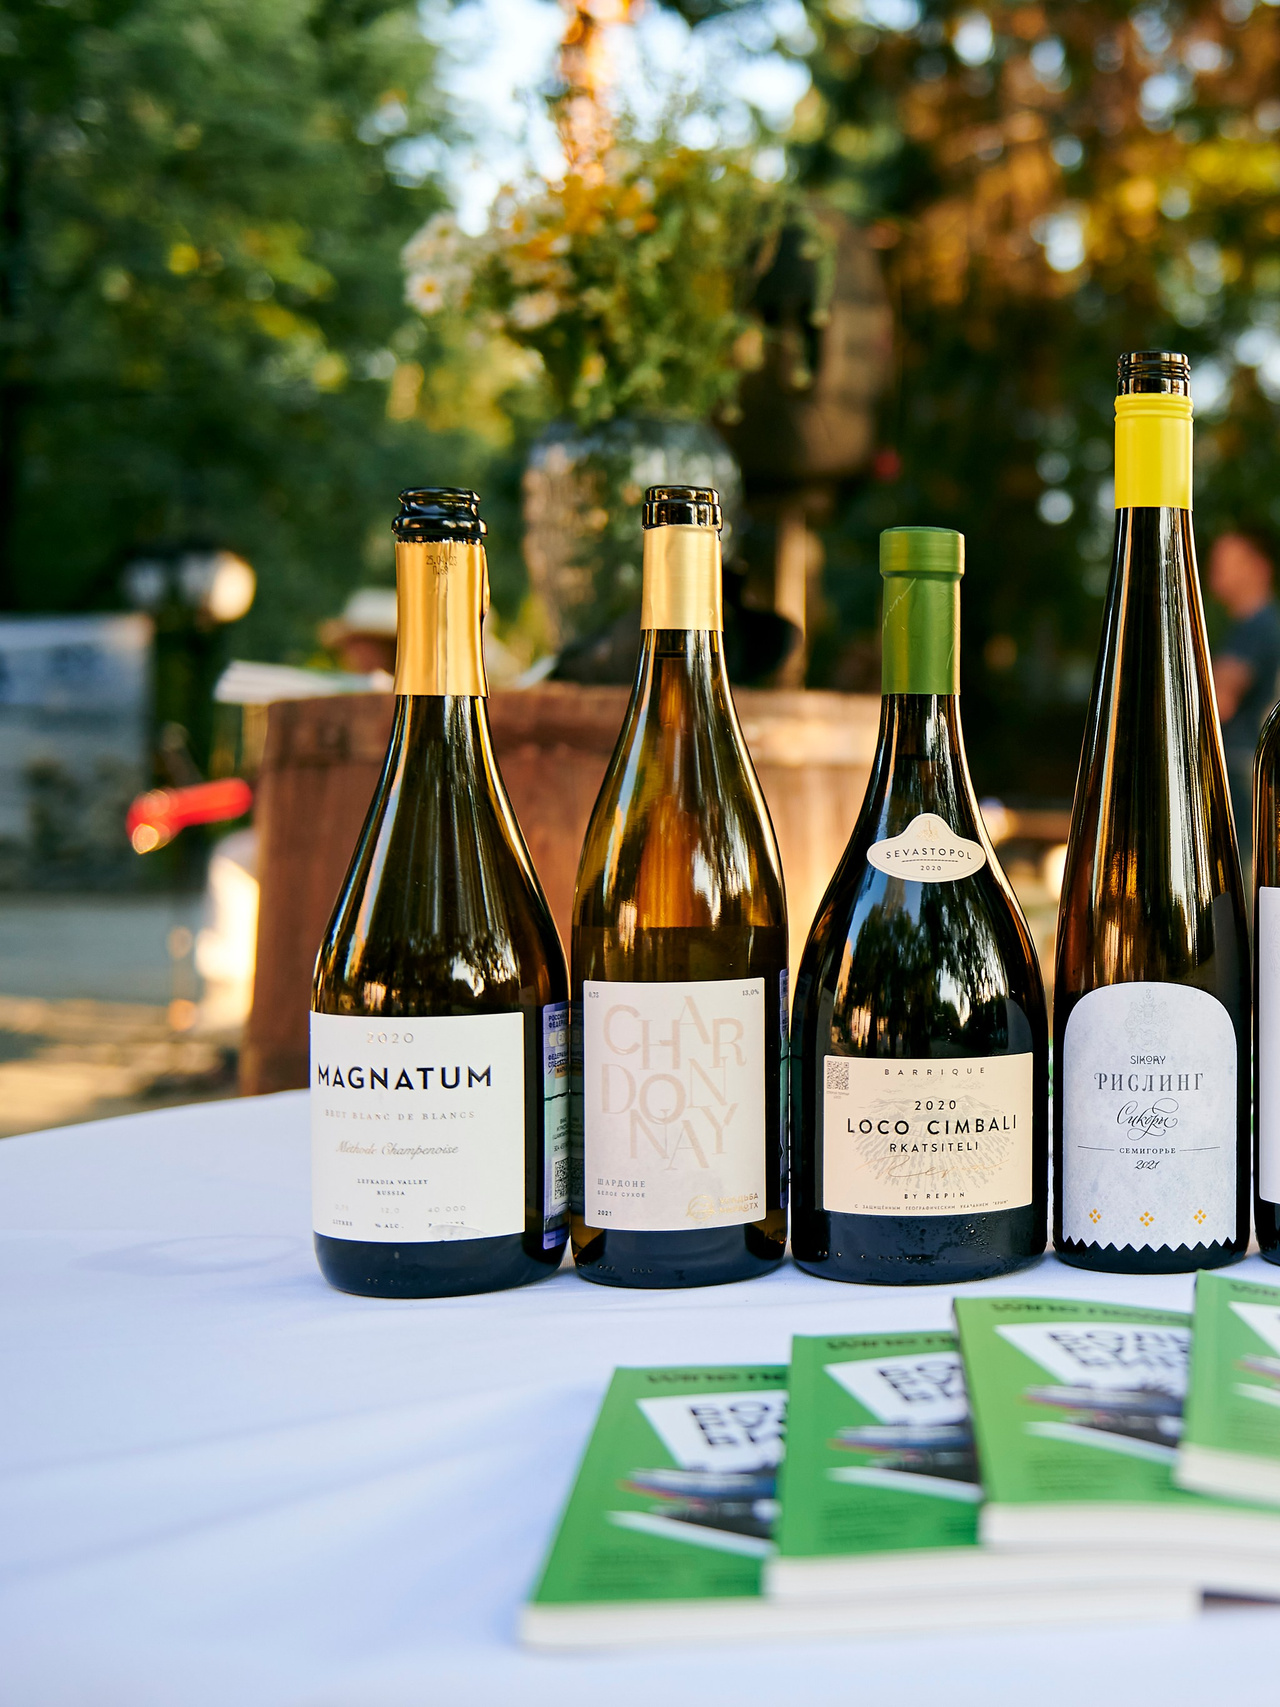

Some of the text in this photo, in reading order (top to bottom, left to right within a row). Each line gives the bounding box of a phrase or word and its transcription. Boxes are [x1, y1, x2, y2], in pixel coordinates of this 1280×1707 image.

[886, 847, 972, 860] SEVASTOPOL
[367, 1032, 415, 1044] 2020
[317, 1063, 492, 1090] MAGNATUM
[884, 1067, 985, 1076] BARRIQUE
[1093, 1072, 1204, 1092] РИСЛИНГ
[914, 1100, 957, 1111] 2020
[325, 1108, 475, 1121] BRUT BLANC DE BLANCS
[847, 1114, 1017, 1135] LOCO CIMBALI
[381, 1142, 459, 1161] Champenoise
[889, 1141, 979, 1153] RKATSITELI
[1119, 1147, 1176, 1155] СЕМИГОРЬЕ
[598, 1178, 646, 1187] ШАРДОНЕ
